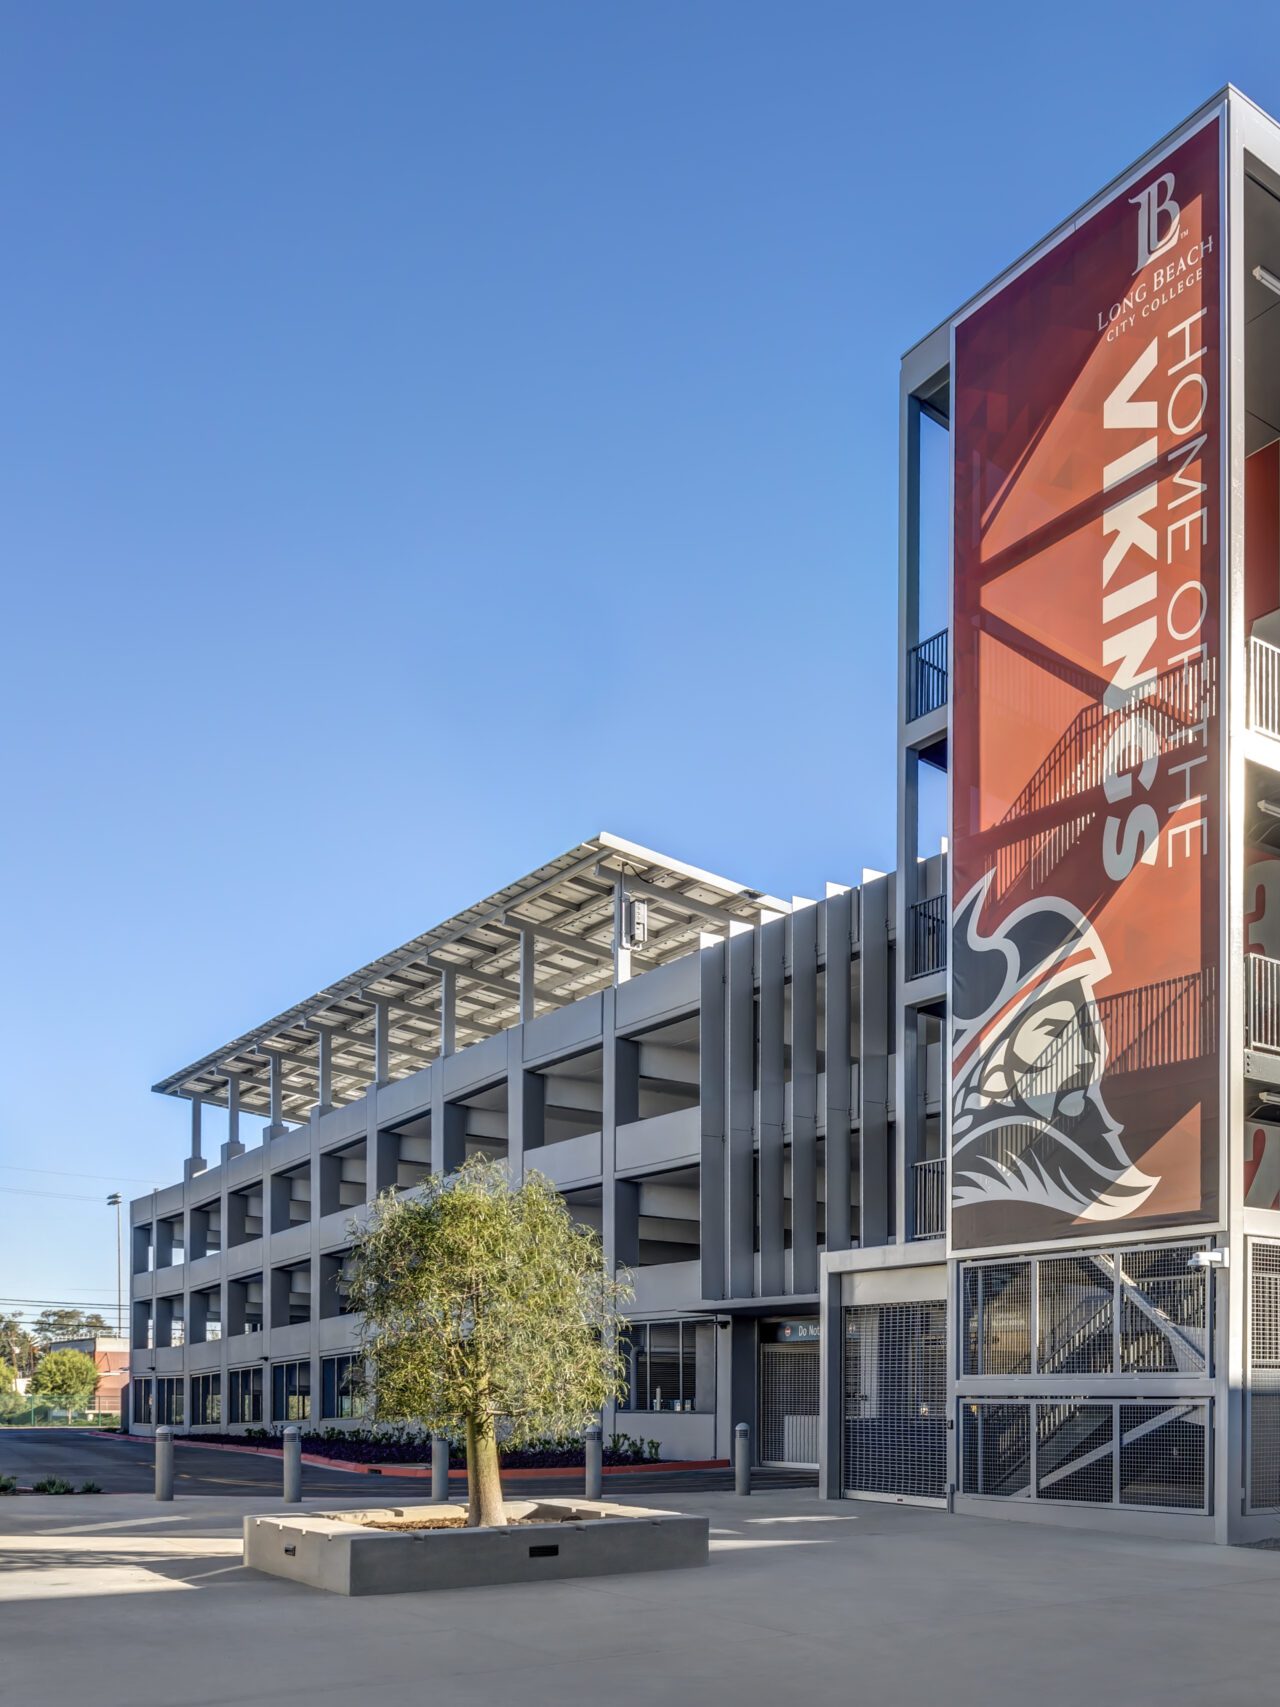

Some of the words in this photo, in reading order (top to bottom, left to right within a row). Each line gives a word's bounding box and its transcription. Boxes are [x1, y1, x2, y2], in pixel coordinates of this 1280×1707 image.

[1098, 283, 1147, 332] LONG
[1153, 234, 1213, 292] BEACH
[1106, 314, 1136, 342] CITY
[1141, 267, 1203, 318] COLLEGE
[1167, 307, 1208, 564] HOME
[1102, 335, 1160, 881] VIKINGS
[1167, 580, 1208, 686] OF
[1167, 702, 1208, 868] THE
[798, 1325, 807, 1337] Do
